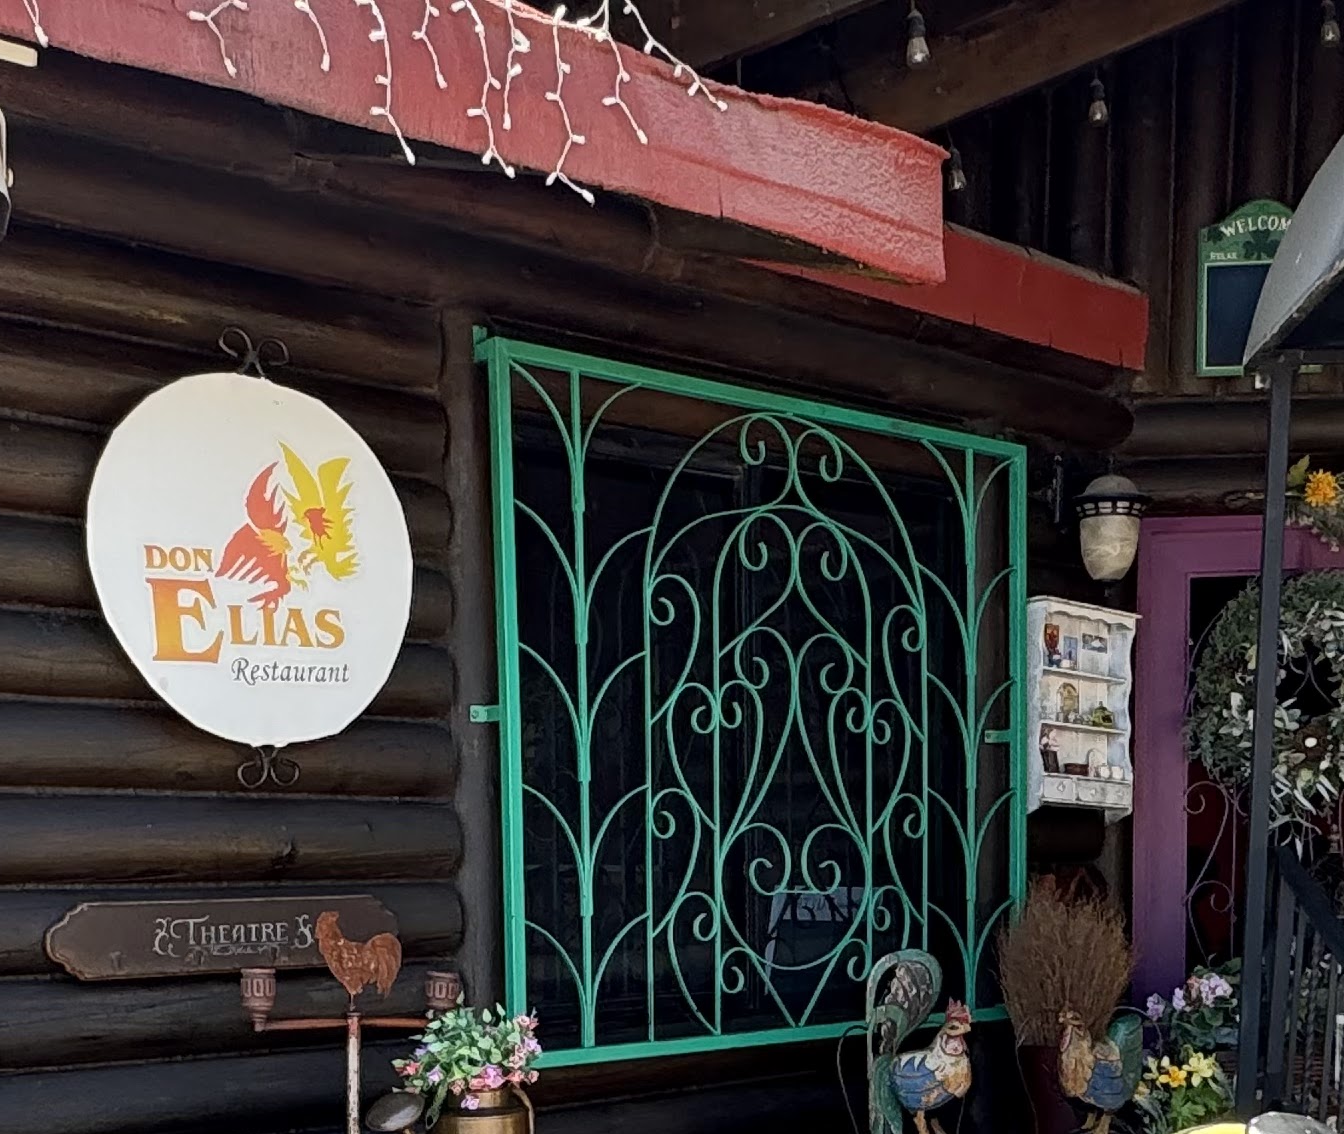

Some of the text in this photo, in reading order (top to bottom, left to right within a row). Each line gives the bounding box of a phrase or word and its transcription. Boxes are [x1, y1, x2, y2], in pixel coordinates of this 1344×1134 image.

[1219, 214, 1293, 237] WELCOM
[143, 543, 215, 573] DON
[145, 577, 346, 665] ELIAS
[230, 656, 351, 686] Restaurant
[169, 914, 290, 946] THEATRE
